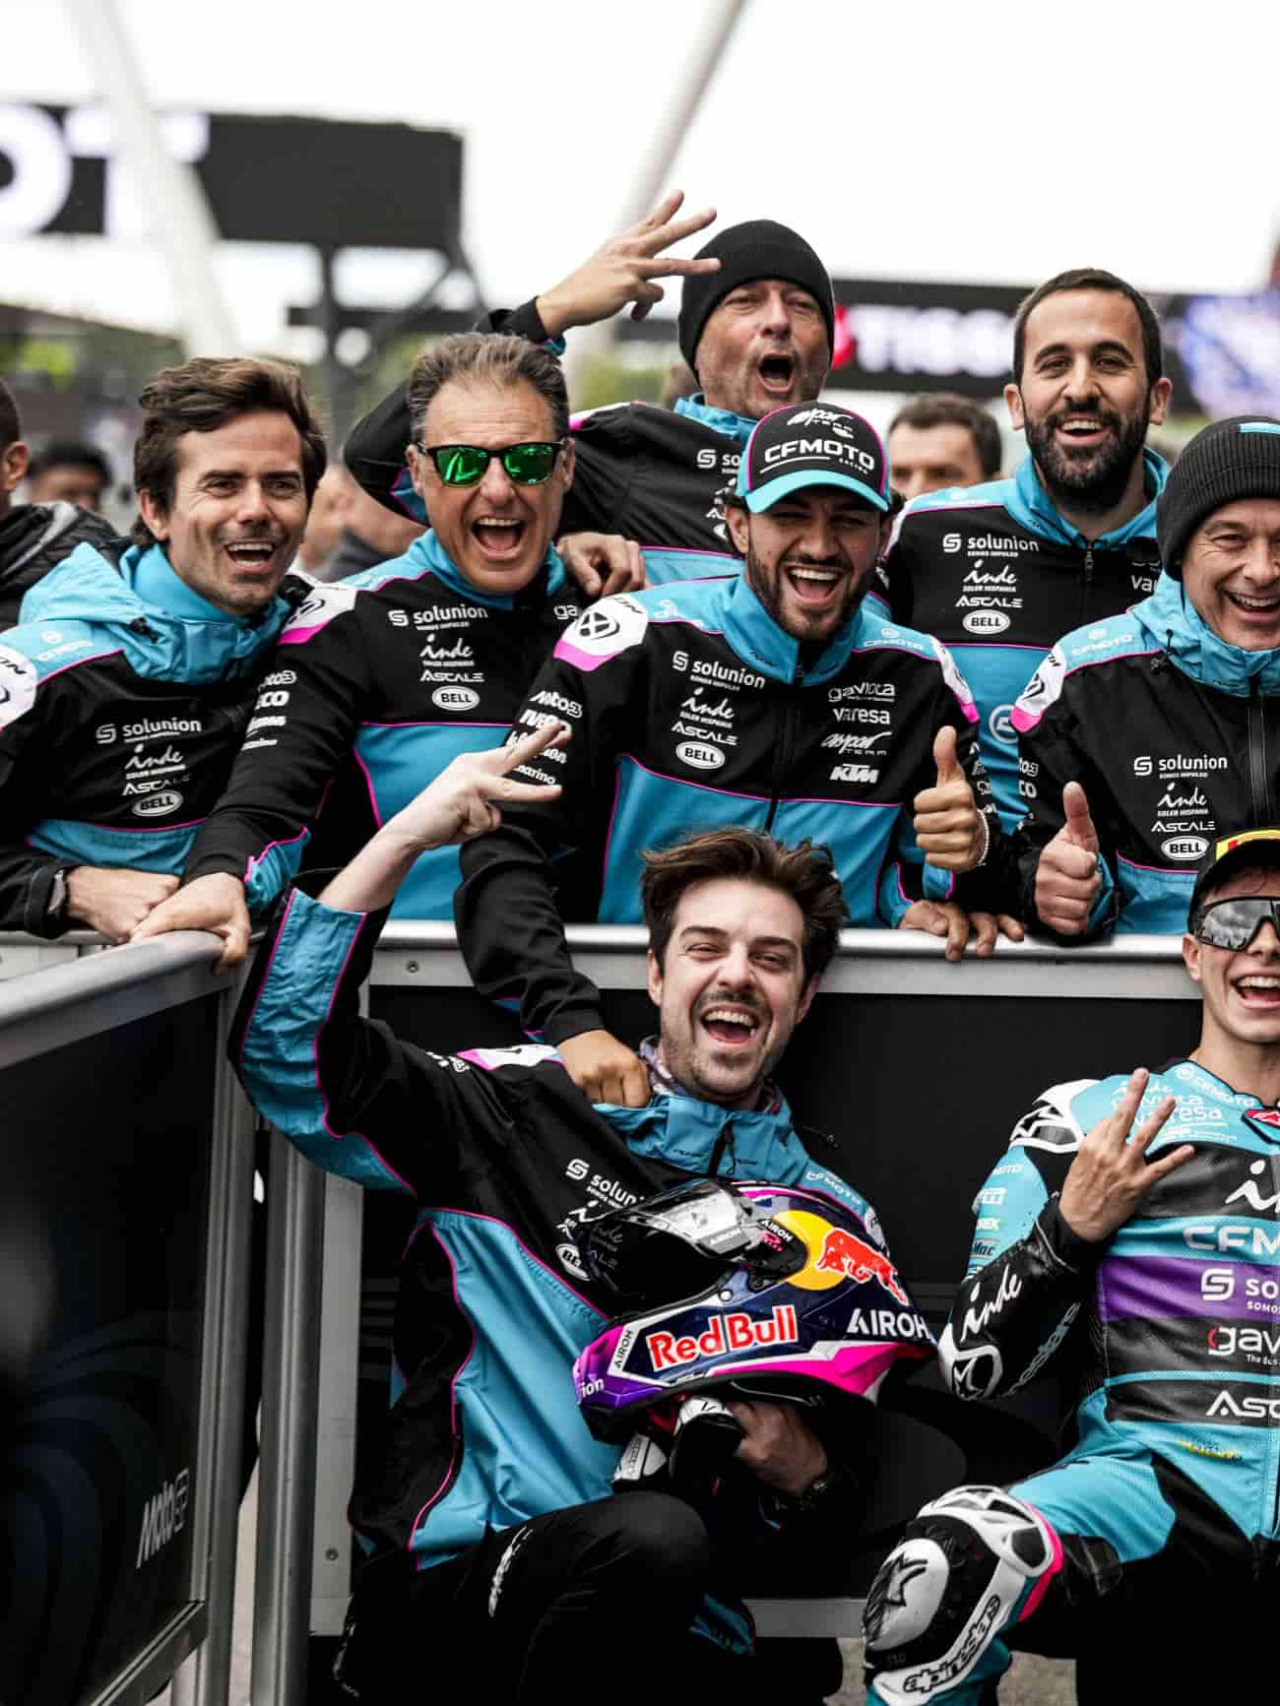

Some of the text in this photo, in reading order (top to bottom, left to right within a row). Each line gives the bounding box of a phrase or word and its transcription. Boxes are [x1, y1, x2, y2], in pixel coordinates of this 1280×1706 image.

[764, 439, 875, 471] CFMOTO
[967, 533, 1040, 552] solunion
[963, 559, 1017, 584] inde
[955, 595, 1024, 608] ASCALE
[413, 604, 488, 624] solunion
[971, 617, 1001, 627] BELL
[420, 634, 473, 660] inde
[420, 670, 486, 683] ASCALE
[692, 660, 766, 689] solunion
[441, 693, 472, 704] BELL
[681, 687, 735, 719] inde
[122, 717, 201, 738] solunion
[671, 721, 739, 746] ASCALE
[124, 743, 184, 770] inde
[684, 748, 717, 764] BELL
[1159, 754, 1228, 771] solunion
[830, 763, 880, 784] KTM
[141, 795, 173, 811] BELL
[1157, 782, 1207, 808] inde
[1151, 821, 1216, 832] ASCALE
[1169, 843, 1202, 853] BELL
[762, 1219, 793, 1242] AIROH
[960, 1263, 1022, 1343] inde
[847, 1308, 932, 1340] AIROH
[645, 1305, 798, 1372] Red Bull
